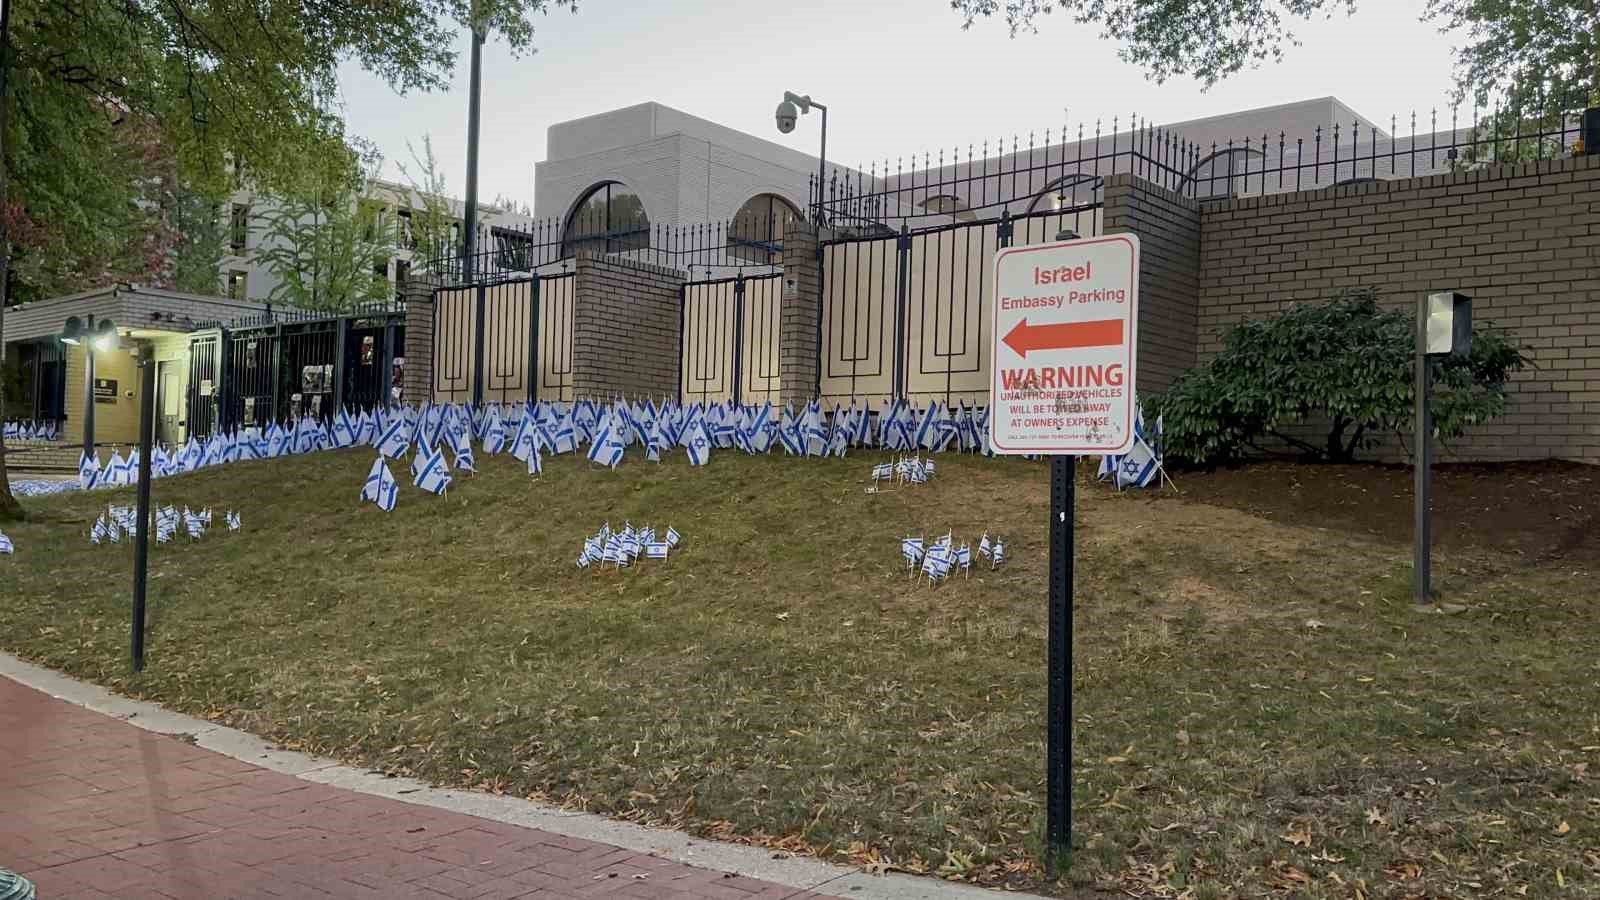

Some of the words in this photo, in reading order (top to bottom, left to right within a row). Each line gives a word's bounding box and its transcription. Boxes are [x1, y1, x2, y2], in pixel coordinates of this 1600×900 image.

[1034, 261, 1090, 285] Israel
[1002, 295, 1064, 310] Embassy
[1069, 288, 1125, 304] Parking
[1001, 364, 1123, 390] WARNING
[1001, 390, 1073, 400] UNAUTHORIZED
[1074, 388, 1122, 398] VEHICLES
[1010, 405, 1032, 414] WILL
[1034, 404, 1046, 413] BE
[1047, 404, 1081, 414] TOWED
[1084, 403, 1110, 412] AWAY
[1010, 418, 1022, 428] AT
[1024, 418, 1064, 428] OWNERS
[1066, 416, 1109, 426] EXPENSE
